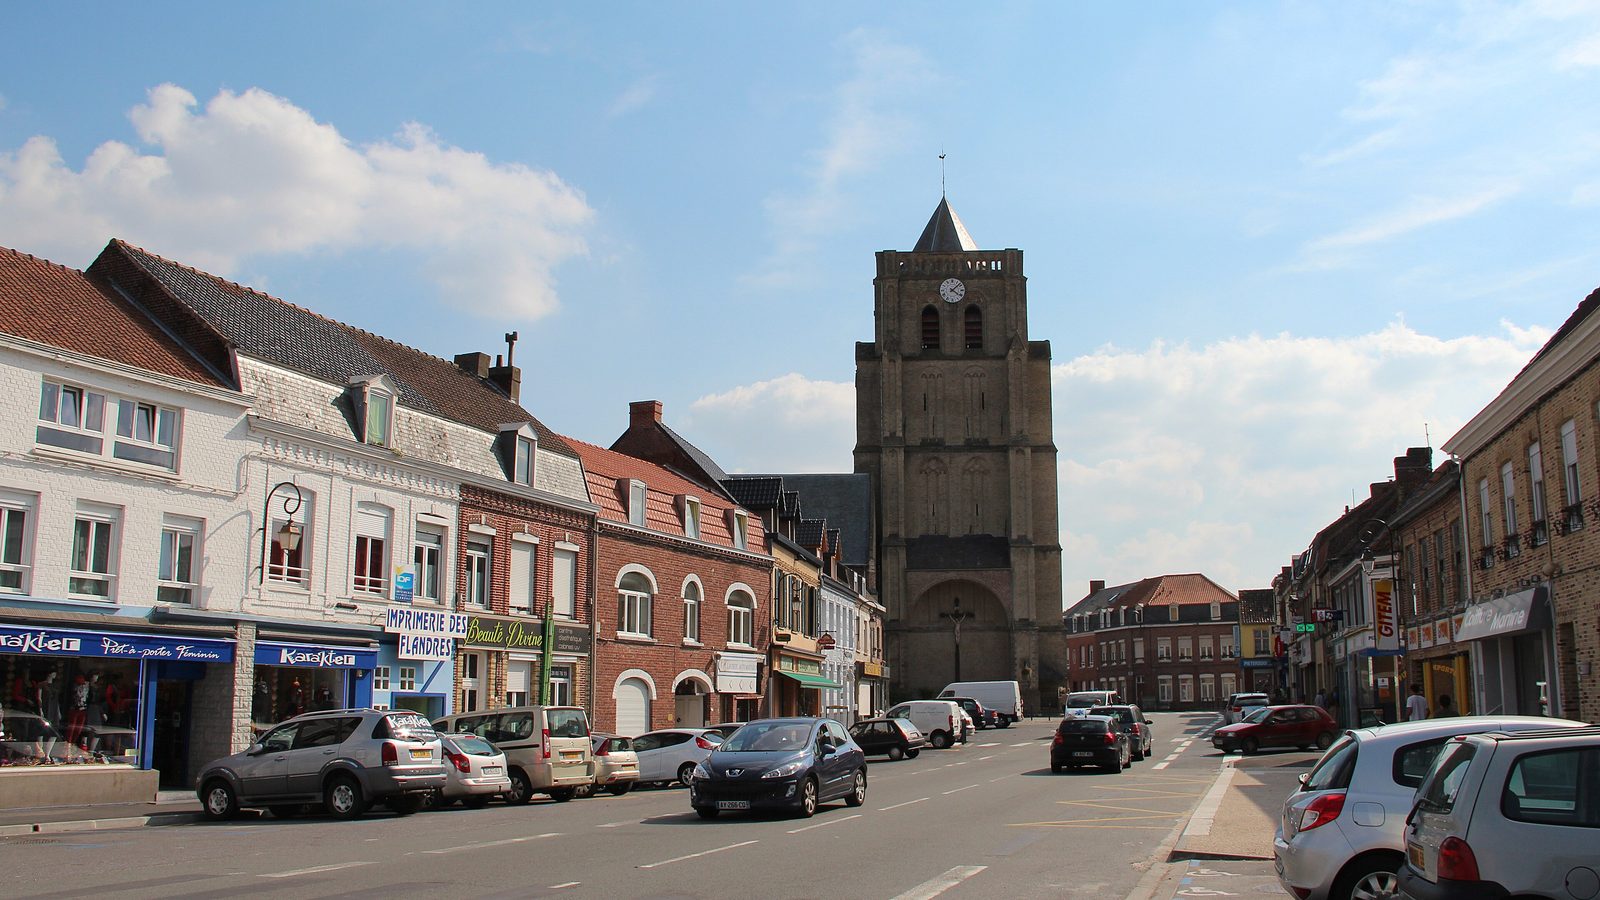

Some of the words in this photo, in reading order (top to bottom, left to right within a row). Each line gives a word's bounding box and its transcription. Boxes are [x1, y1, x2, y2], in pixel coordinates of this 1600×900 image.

[386, 608, 445, 632] IMPRIMERIE
[449, 614, 467, 634] DES
[1376, 591, 1394, 638] GITEM
[463, 617, 503, 646] Beauté
[506, 619, 543, 649] Divine
[176, 645, 220, 659] Féminin
[280, 648, 355, 667] Karakter
[399, 635, 452, 658] FLANDRES
